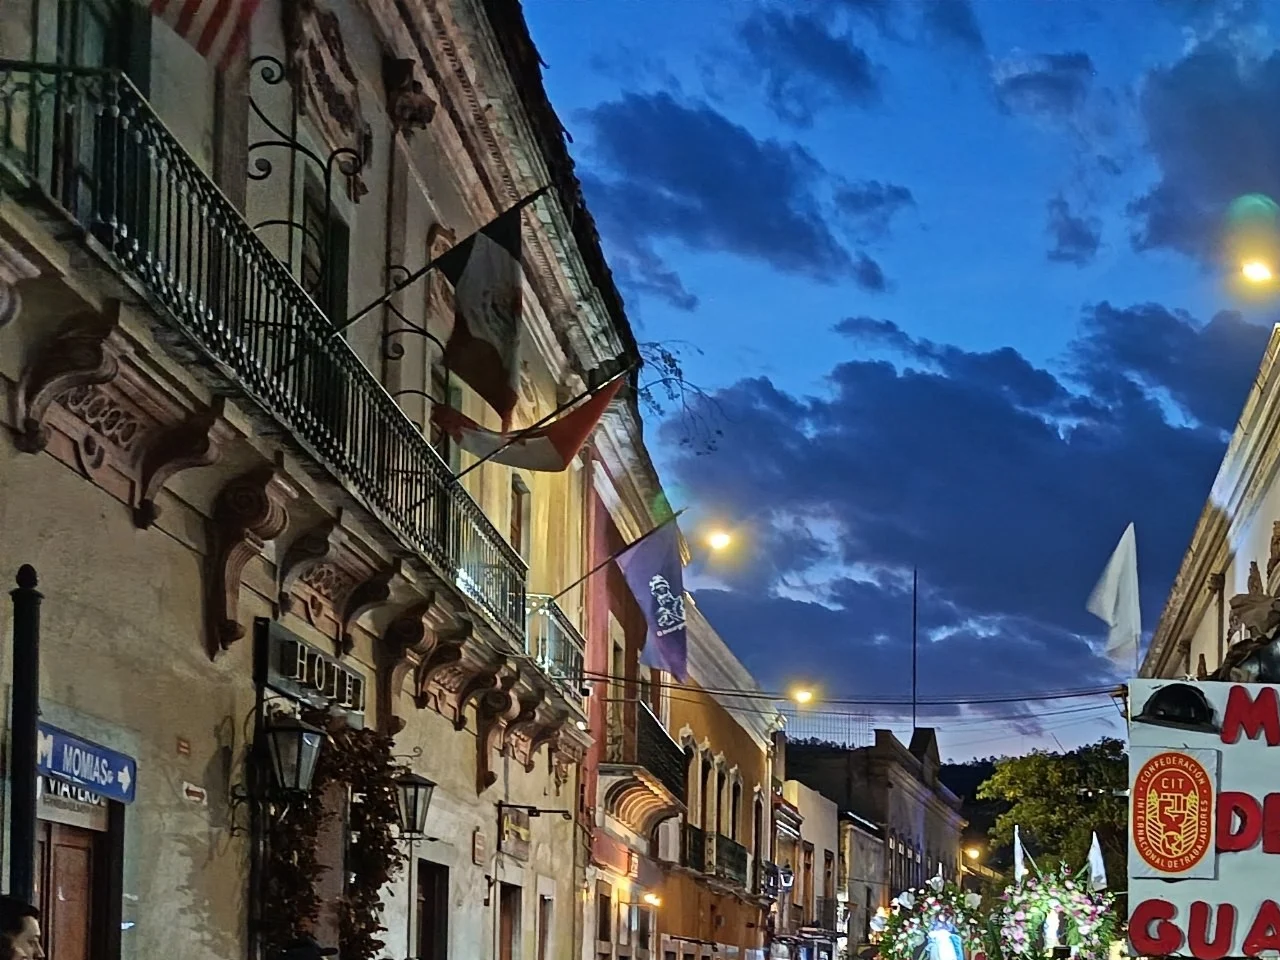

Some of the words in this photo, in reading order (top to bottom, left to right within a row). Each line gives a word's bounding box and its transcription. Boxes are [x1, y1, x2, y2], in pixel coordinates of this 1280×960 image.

[290, 641, 365, 715] HOTEL
[62, 743, 109, 786] MOMIAS
[1140, 756, 1206, 784] CONFEDERACIÓN
[1161, 777, 1185, 789] CIT
[1136, 797, 1165, 867] INTERNACIONAL
[1167, 859, 1179, 869] DE
[1179, 799, 1209, 865] TRABAJADORES
